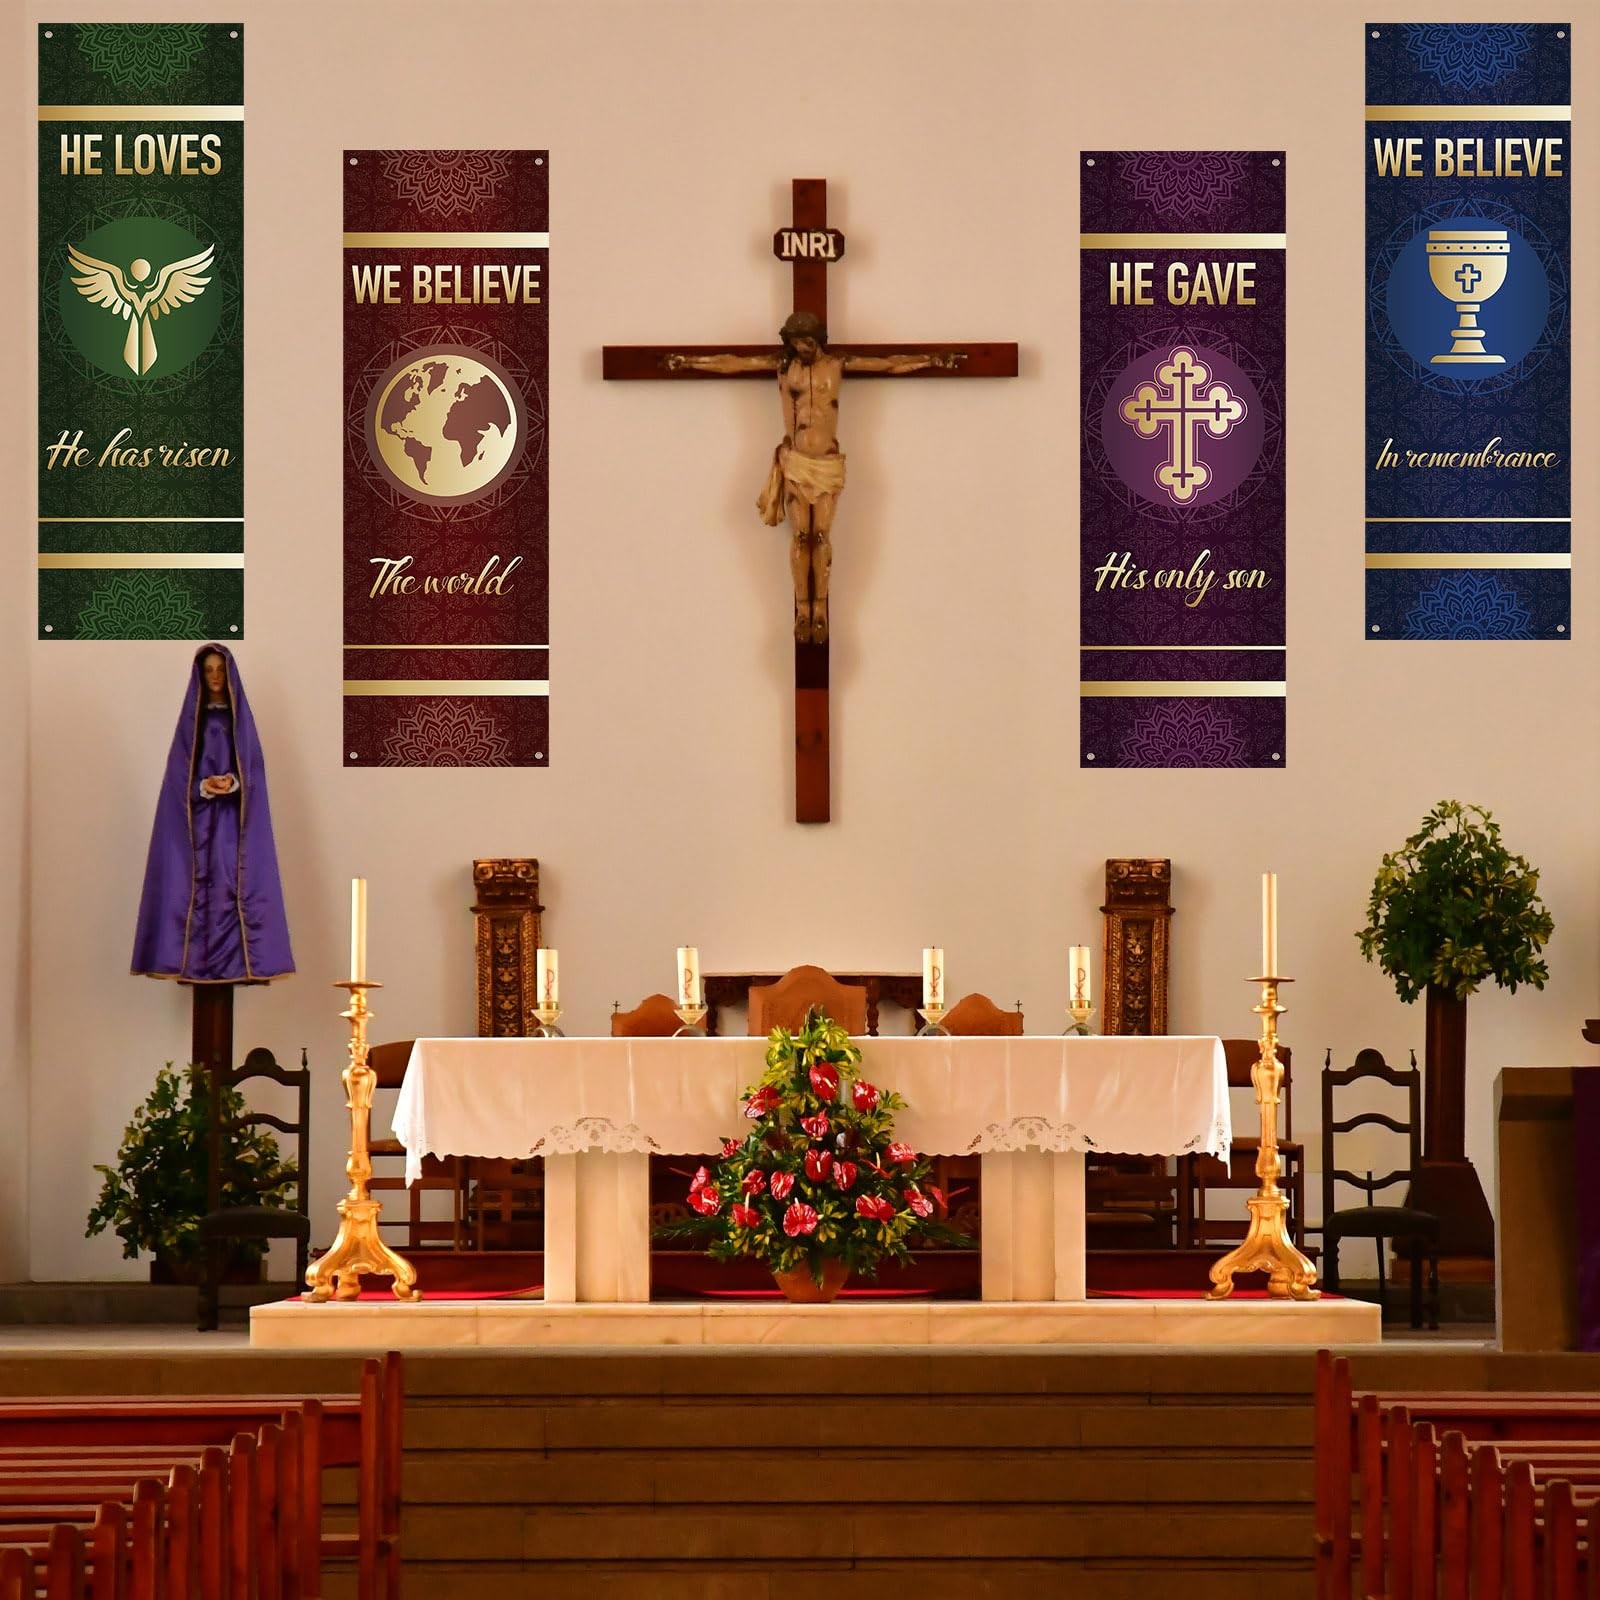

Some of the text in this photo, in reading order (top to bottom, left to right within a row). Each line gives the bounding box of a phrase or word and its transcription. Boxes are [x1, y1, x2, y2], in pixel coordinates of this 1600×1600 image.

[60, 133, 222, 176] HE LOVES
[1373, 136, 1563, 178] WE BELIEVE
[781, 231, 836, 258] INRI
[351, 263, 541, 306] WE BELIEVE
[1109, 261, 1257, 306] HE GAVE
[46, 427, 236, 471] He has risen
[1375, 436, 1560, 471] In remembrance
[369, 554, 524, 599] The world
[1093, 548, 1272, 609] His only son
